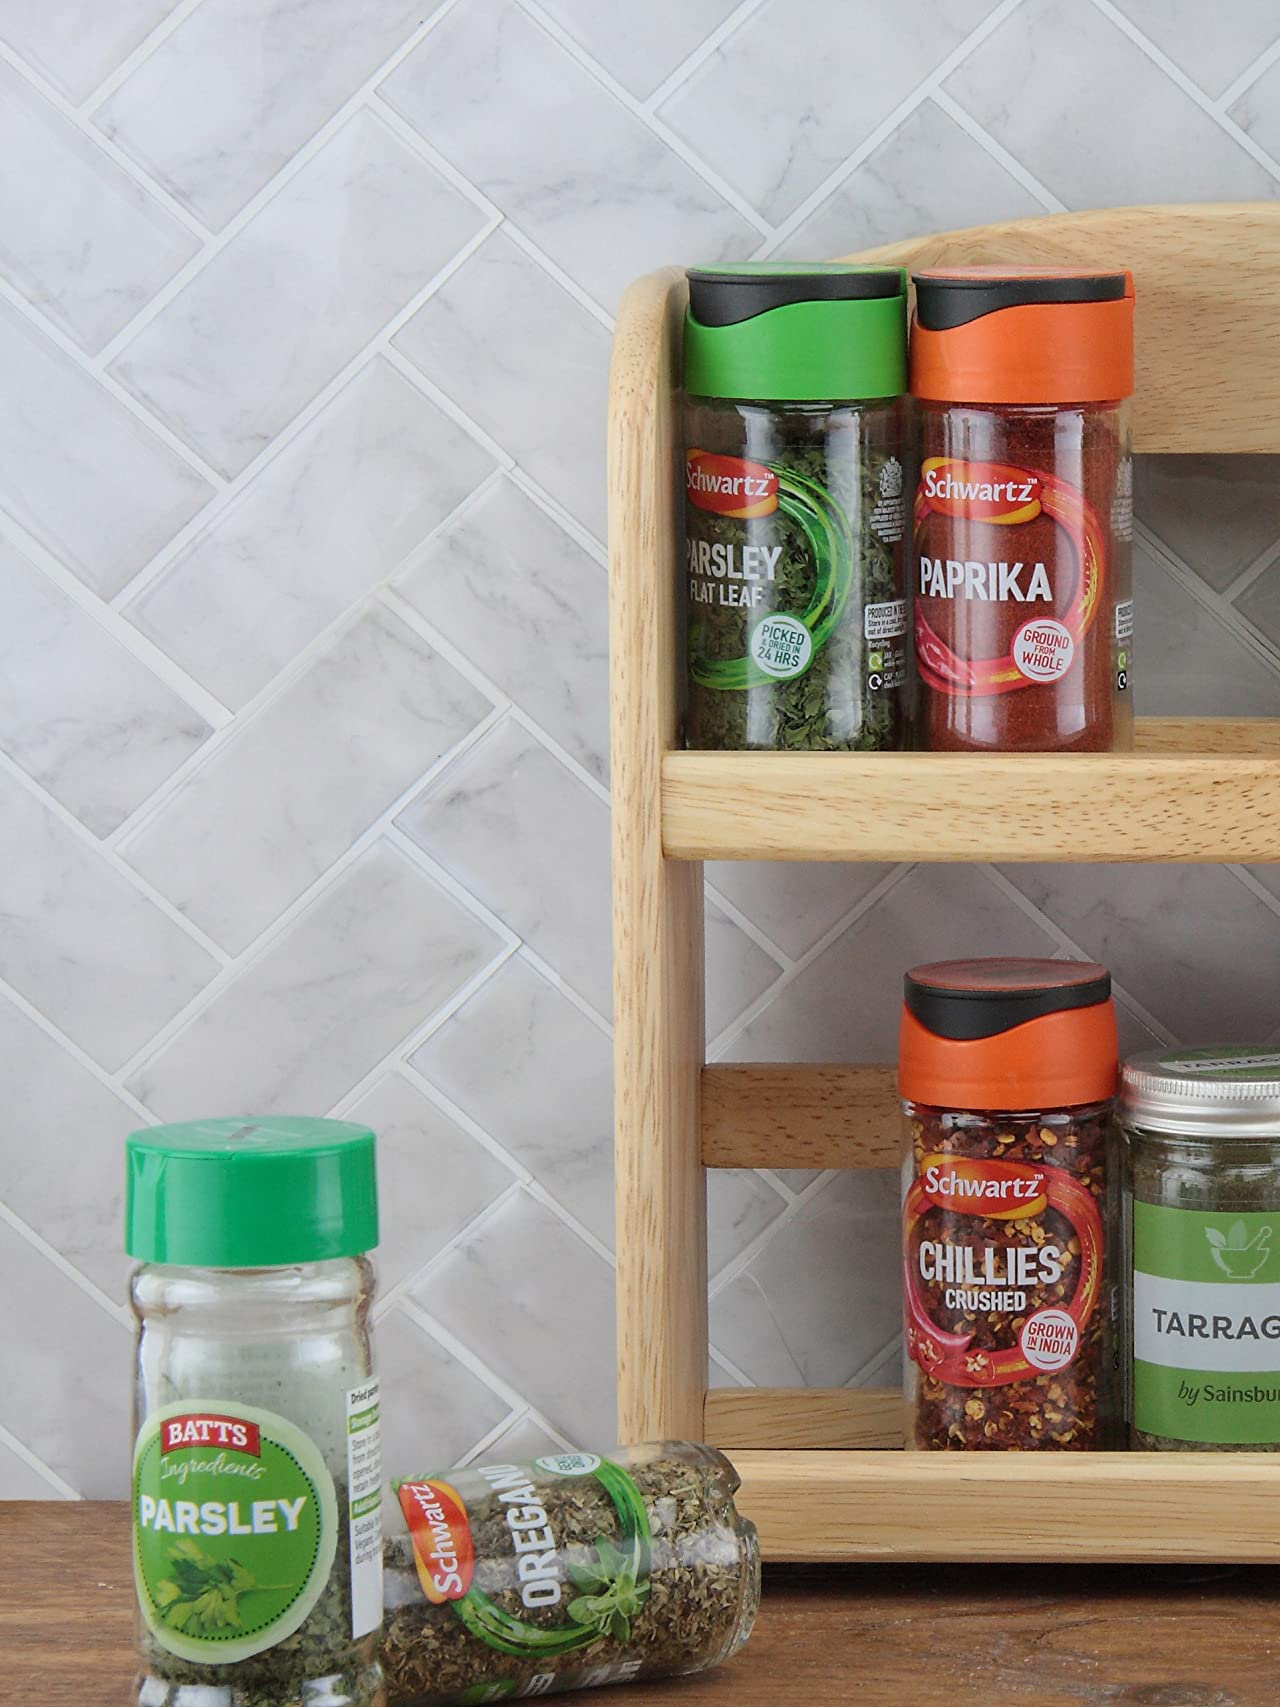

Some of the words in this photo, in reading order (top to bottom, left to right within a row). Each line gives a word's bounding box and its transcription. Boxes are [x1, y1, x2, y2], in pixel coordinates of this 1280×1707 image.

[686, 462, 769, 497] Schwartz
[925, 470, 1034, 502] Schwartz
[919, 556, 1054, 602] PAPRIKA
[690, 579, 716, 604] FLAT
[719, 584, 763, 608] LEAF
[761, 624, 805, 646] PICKED
[768, 639, 791, 652] DRIED
[792, 644, 801, 654] IN
[1023, 629, 1070, 650] GROUND
[757, 647, 772, 661] 24
[774, 650, 800, 667] HRS
[1022, 653, 1064, 671] WHOLE
[1034, 644, 1056, 656] FROM
[925, 1166, 1039, 1198] Schwartz
[919, 1240, 1062, 1286] CHILLIES
[945, 1288, 1026, 1312] CRUSHED
[1028, 1321, 1075, 1339] GROWN
[1028, 1337, 1038, 1347] IN
[1039, 1340, 1072, 1356] INDIA
[1178, 1380, 1200, 1407] by
[168, 1420, 249, 1447] BATTS
[161, 1452, 267, 1486] Ingredients
[139, 1494, 307, 1537] PARSLEY
[410, 1484, 463, 1593] Schwartz
[477, 1463, 562, 1609] OREGANO
